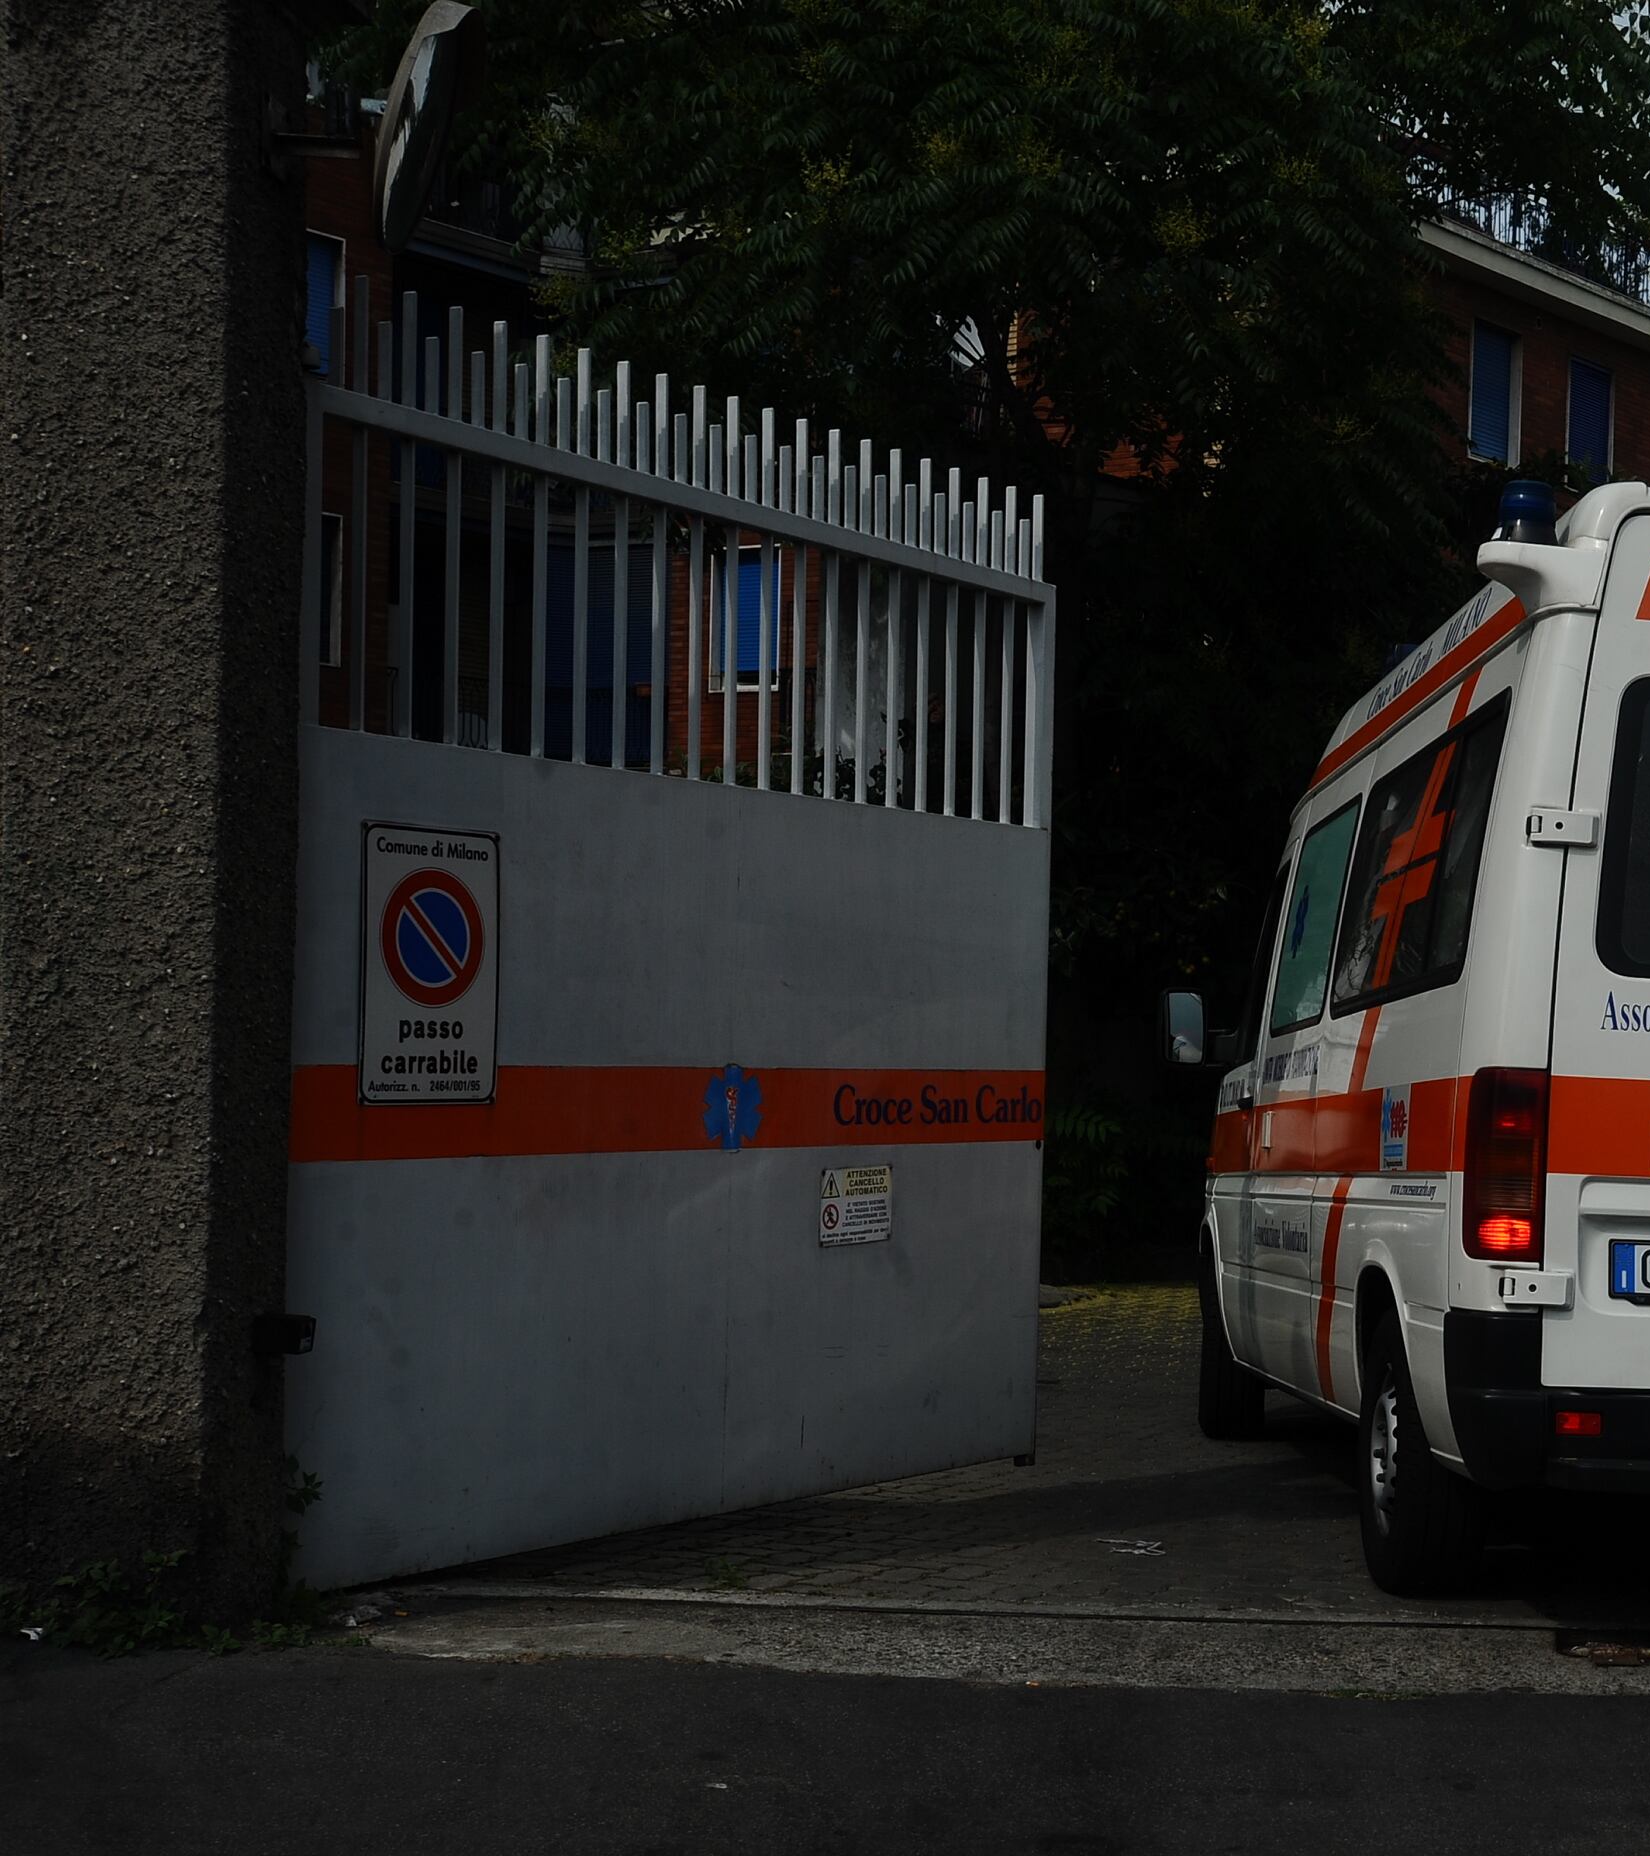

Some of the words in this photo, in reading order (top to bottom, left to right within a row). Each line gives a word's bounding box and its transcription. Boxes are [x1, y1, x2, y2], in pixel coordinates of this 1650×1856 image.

[376, 836, 428, 857] Comune
[431, 841, 443, 858] di
[446, 843, 489, 862] Milano
[399, 1019, 463, 1043] passo
[381, 1050, 478, 1075] carrabile
[411, 1083, 421, 1092] n.
[833, 1084, 913, 1126] Croce
[919, 1084, 969, 1125] San
[975, 1084, 1042, 1124] Carlo
[847, 1168, 887, 1178] ATTENZIONE
[845, 1185, 888, 1196] AUTOMATICO
[849, 1177, 885, 1187] CANCELLO
